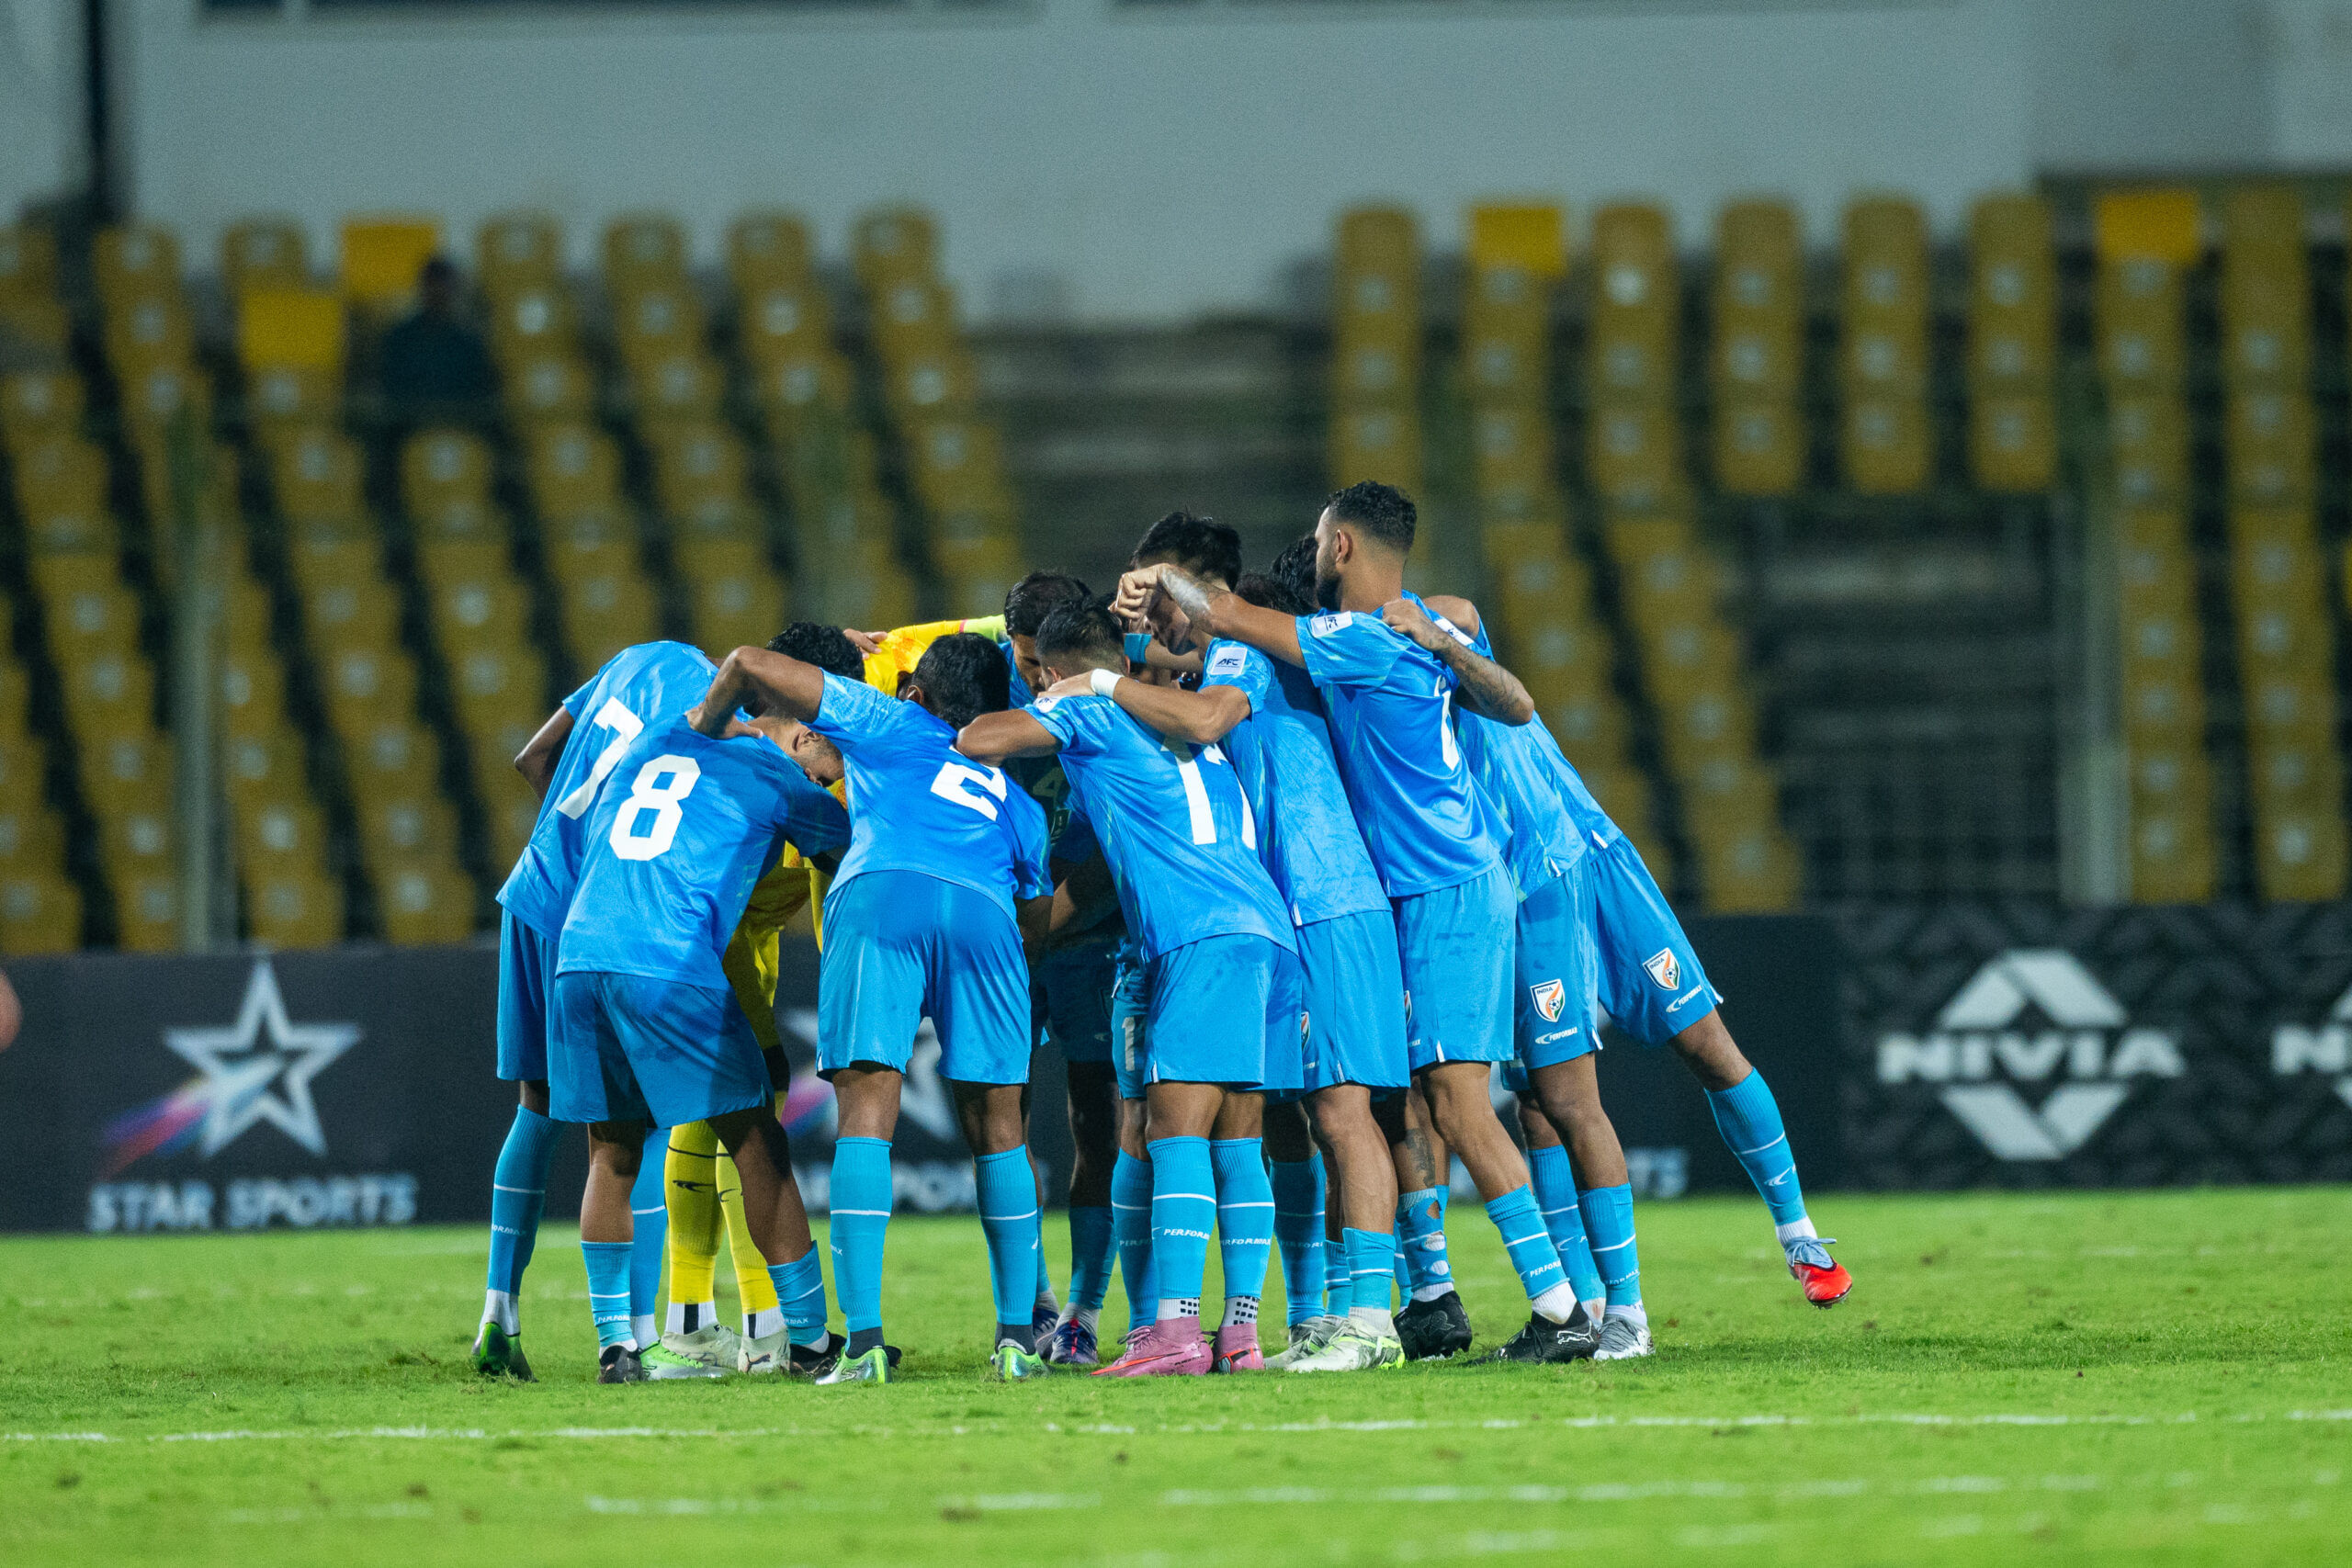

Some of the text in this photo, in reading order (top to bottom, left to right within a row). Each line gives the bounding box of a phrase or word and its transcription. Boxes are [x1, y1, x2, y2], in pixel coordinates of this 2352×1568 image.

[1216, 658, 1242, 666] AFC
[557, 696, 644, 819] 7
[609, 754, 701, 861] 8
[1649, 957, 1665, 969] INDIA
[1536, 987, 1554, 995] INDIA
[1878, 1031, 2185, 1084] NIVIA
[87, 1172, 418, 1232] STAR SPORTS
